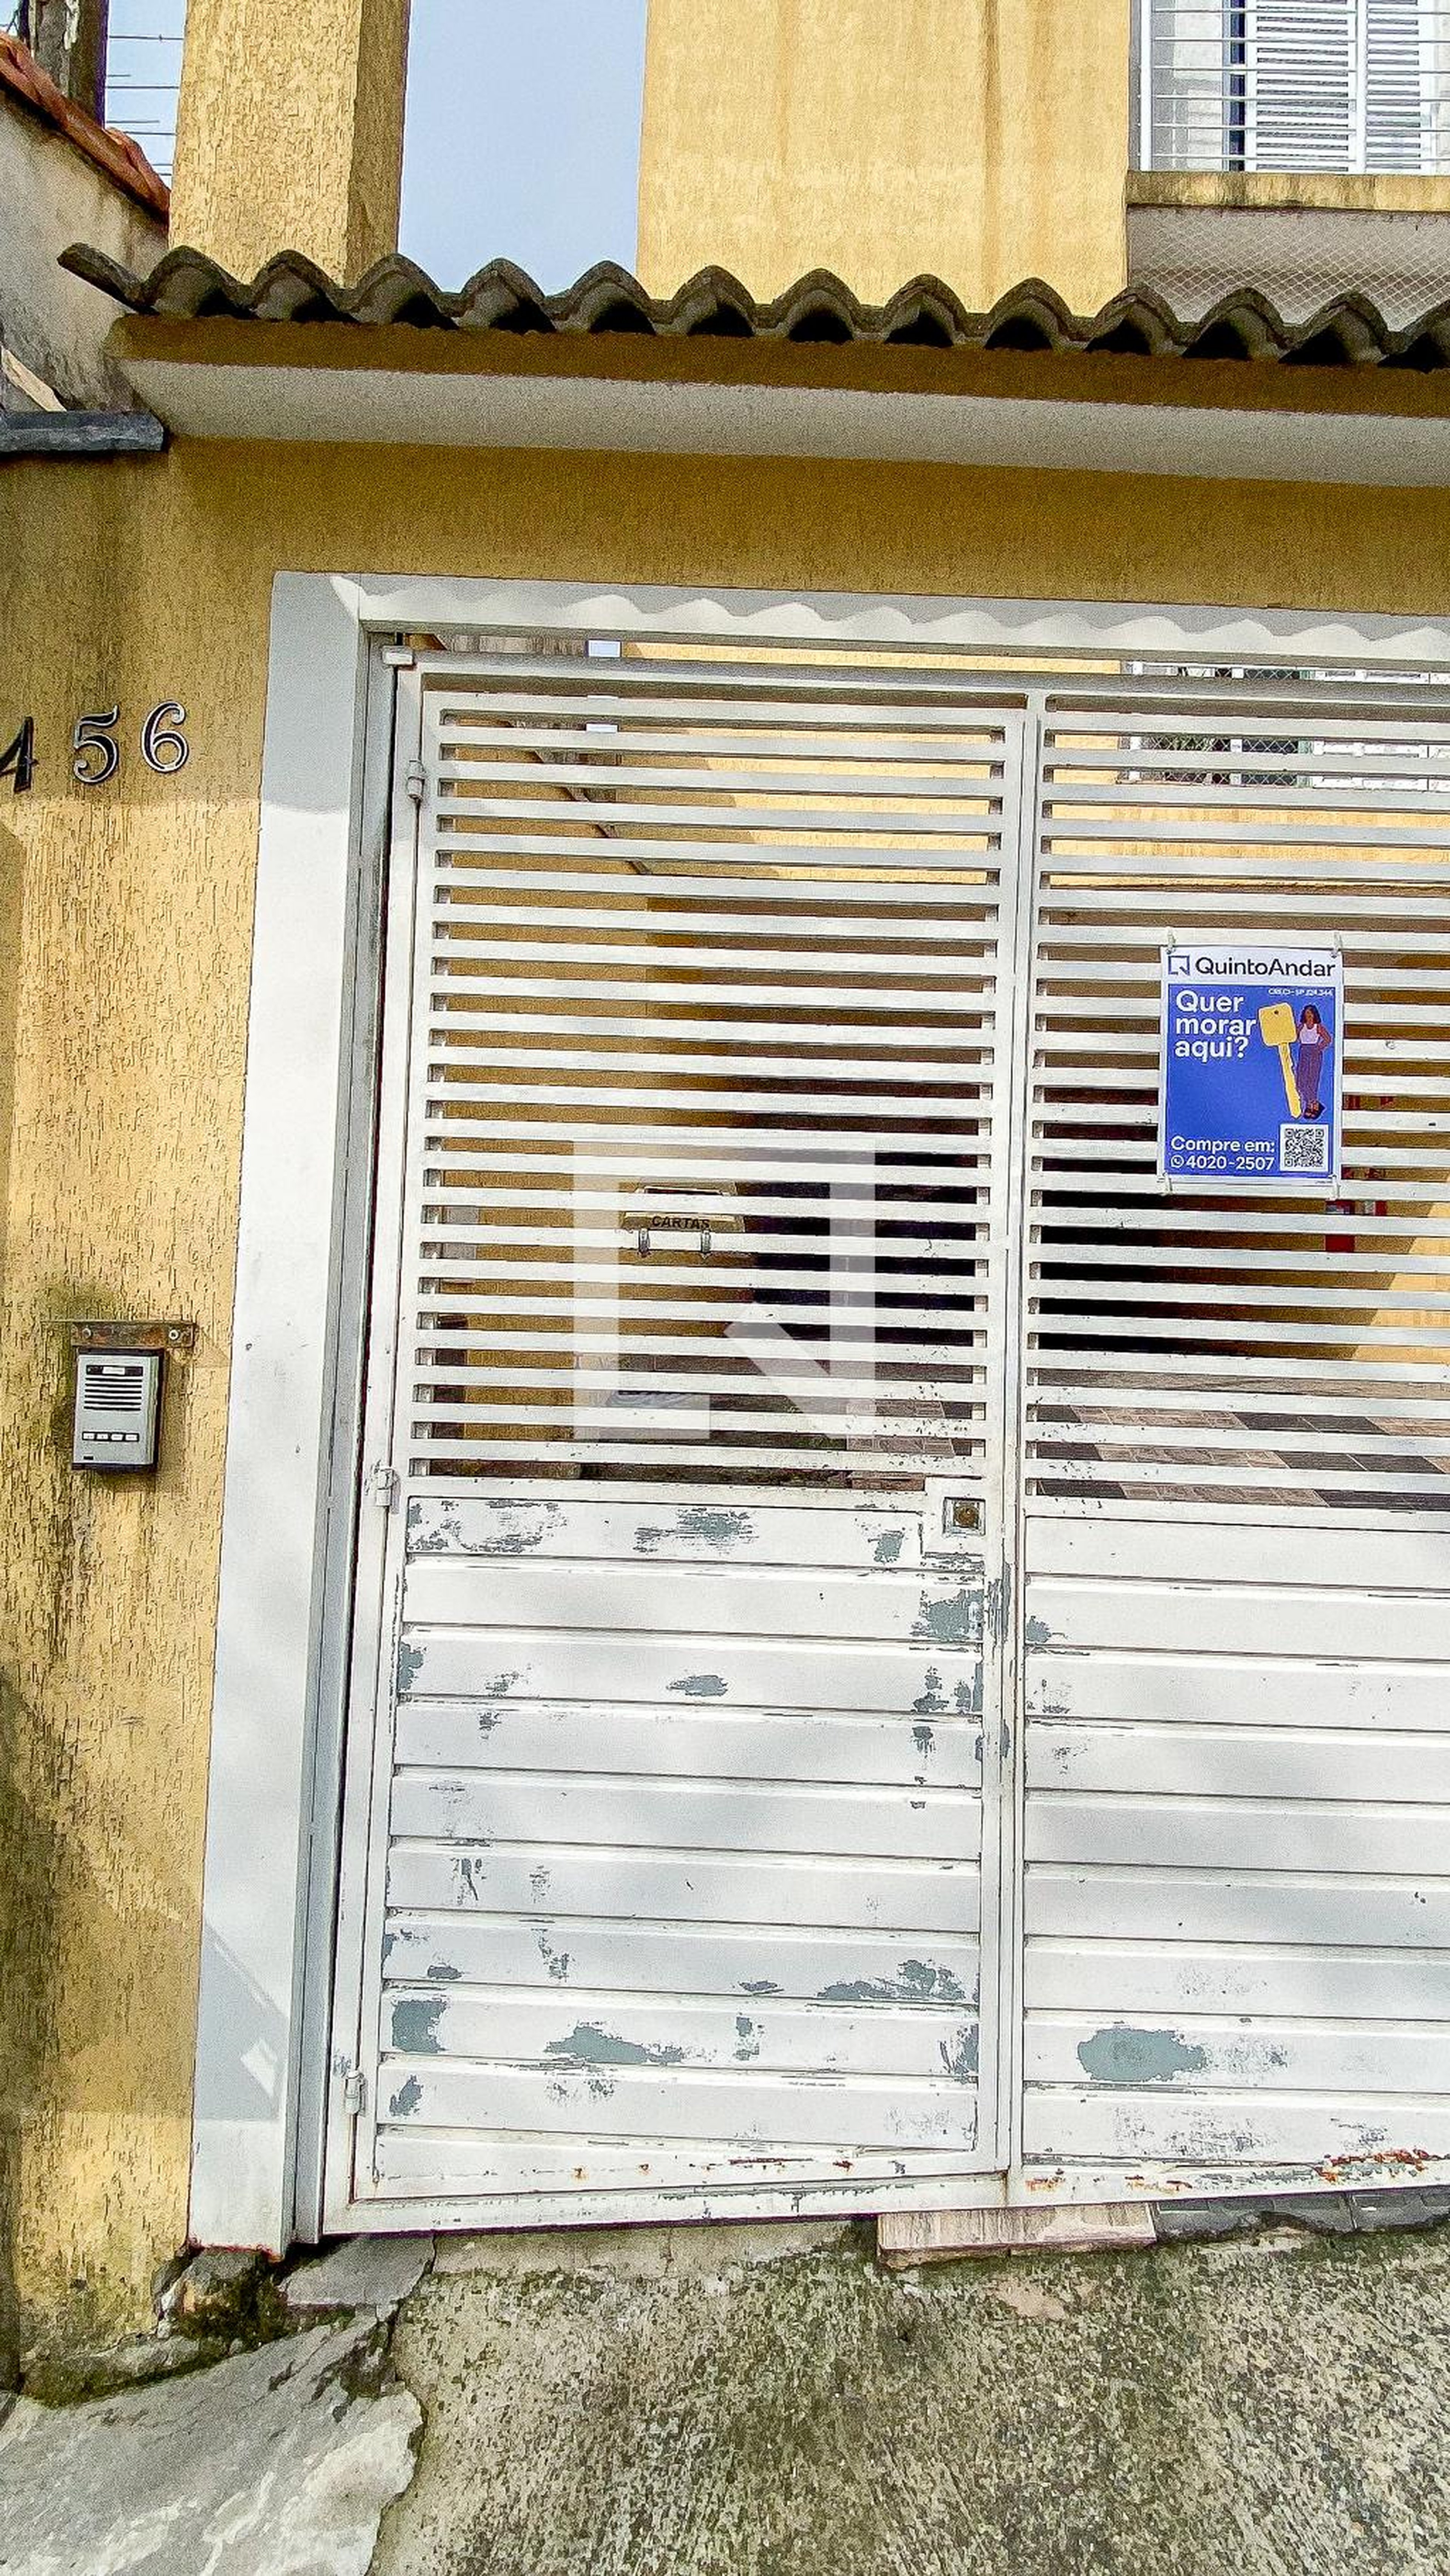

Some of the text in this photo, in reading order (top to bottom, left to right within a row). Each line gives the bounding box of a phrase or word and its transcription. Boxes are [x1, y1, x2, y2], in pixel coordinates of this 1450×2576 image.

[0, 701, 188, 792] 456
[1195, 957, 1336, 976] QuintoAndar
[1176, 990, 1244, 1012] Quer
[1176, 1017, 1256, 1036] morar
[1175, 1037, 1248, 1062] aqui?
[1171, 1136, 1275, 1154] Compre em:
[1186, 1155, 1275, 1170] 4020-2507
[652, 1216, 711, 1229] CARTAS
